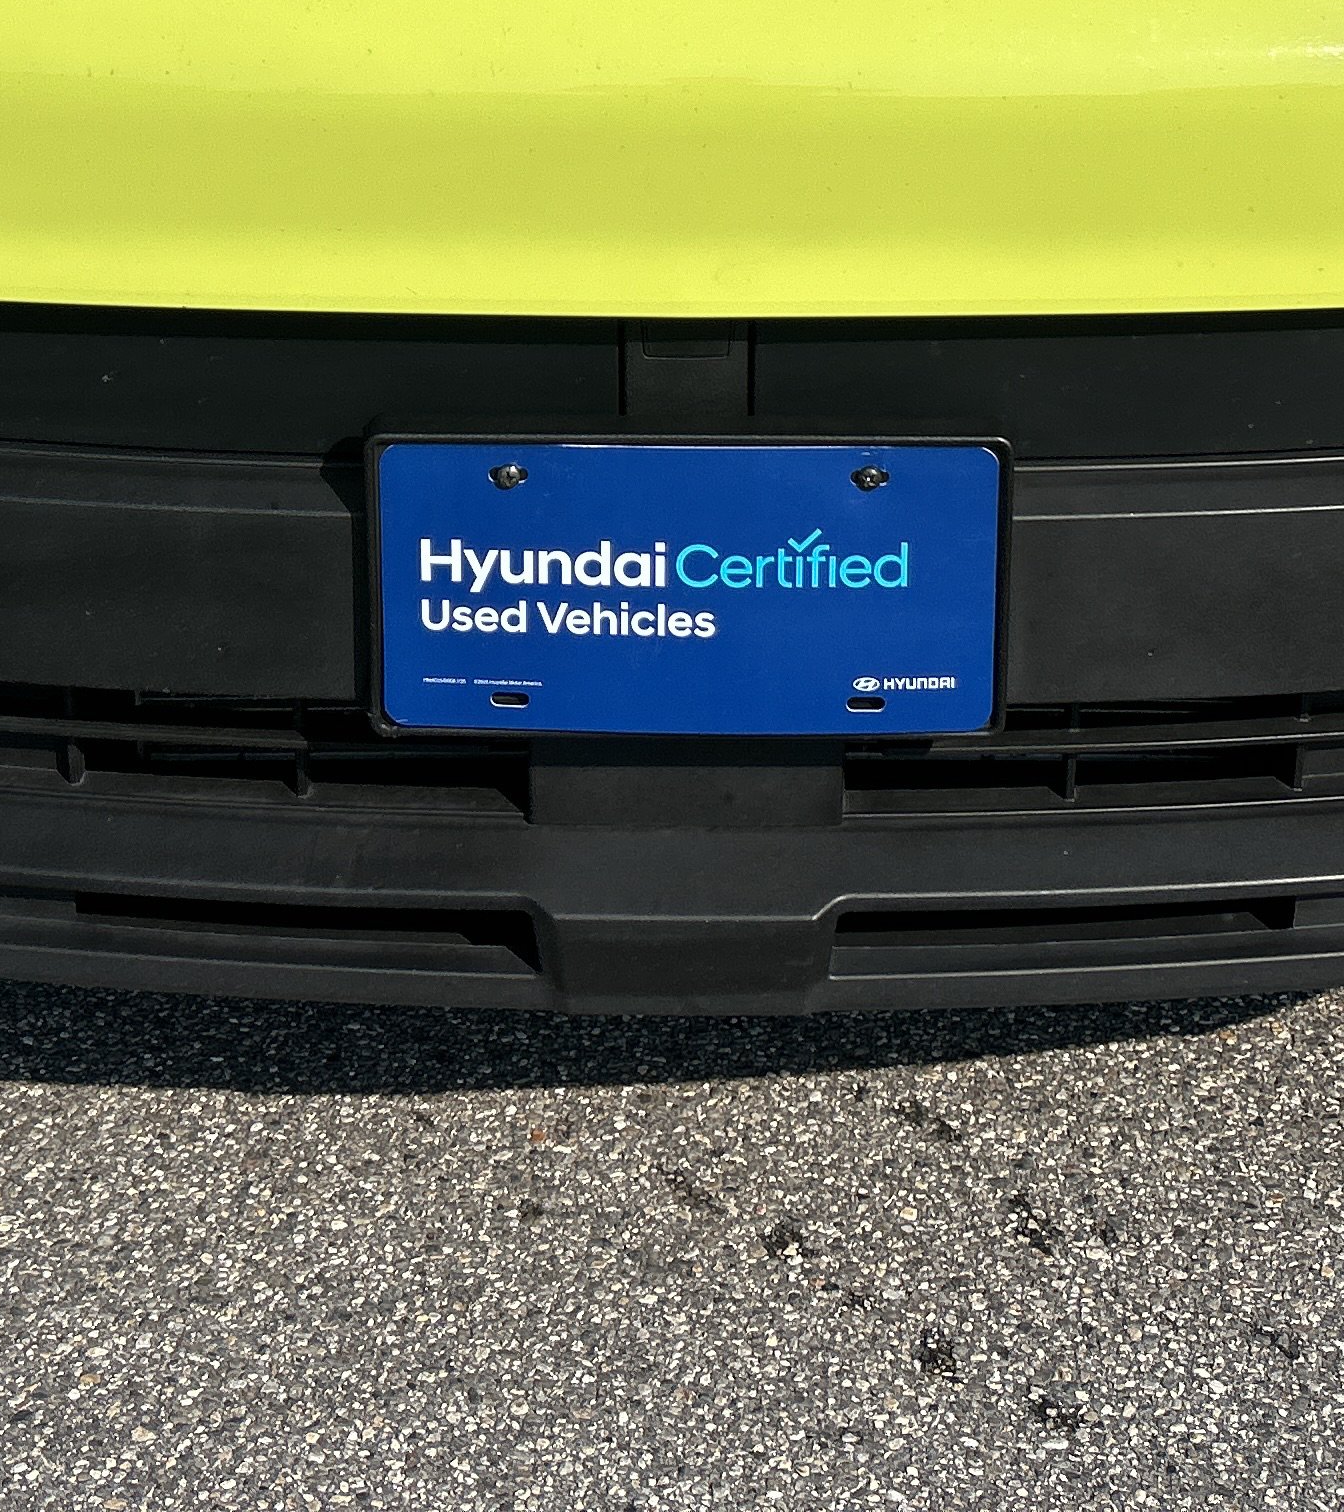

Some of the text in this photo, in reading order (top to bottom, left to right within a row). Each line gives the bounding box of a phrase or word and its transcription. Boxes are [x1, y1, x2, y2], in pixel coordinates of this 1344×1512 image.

[420, 529, 910, 593] Hyundai Certified
[420, 598, 716, 639] Used Vehicles
[883, 676, 957, 691] HYUNDAI
